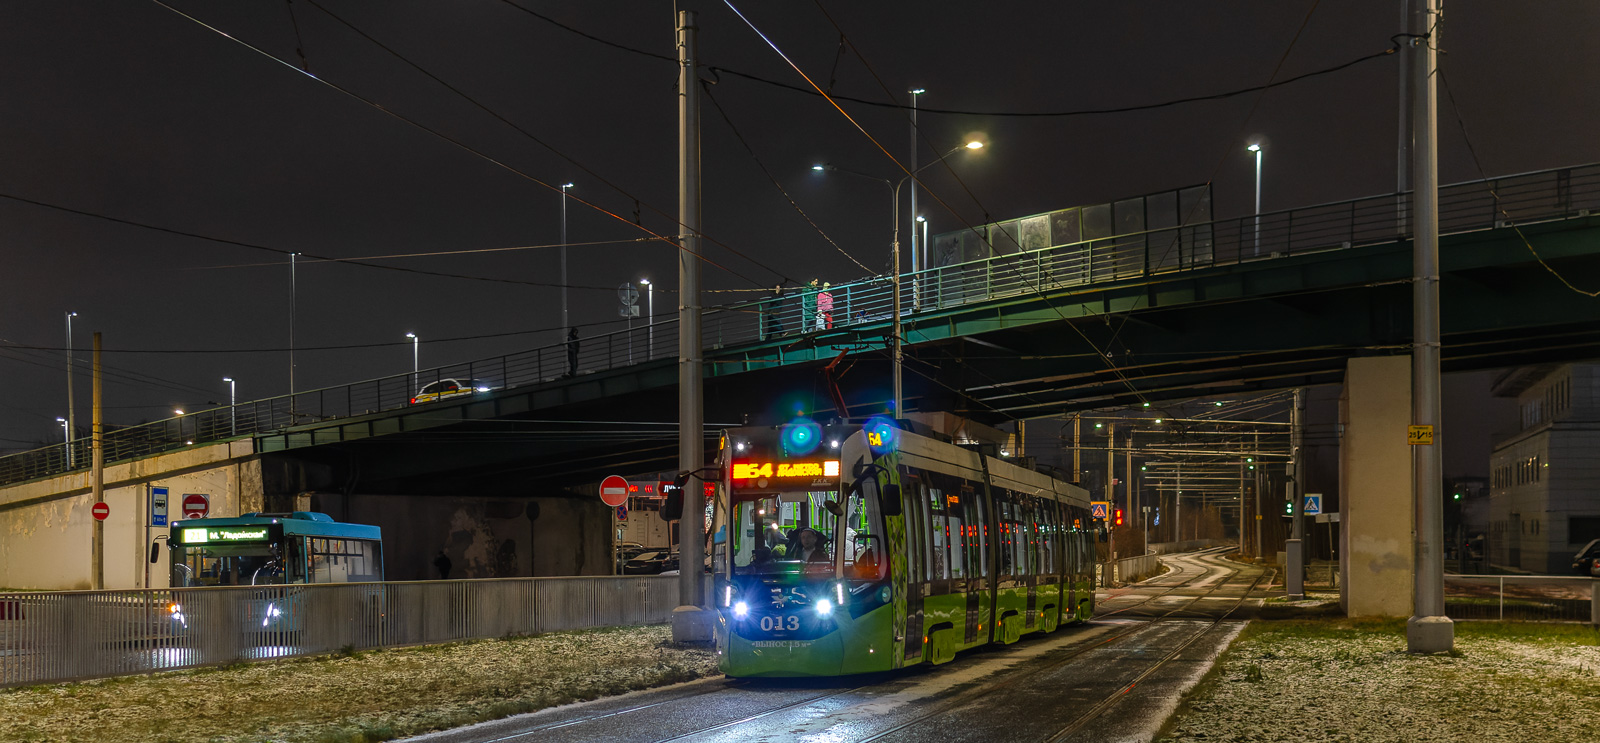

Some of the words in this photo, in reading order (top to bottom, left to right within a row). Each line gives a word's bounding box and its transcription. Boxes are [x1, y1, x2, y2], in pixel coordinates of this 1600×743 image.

[868, 432, 882, 446] 64
[748, 463, 773, 478] 64
[760, 615, 800, 631] 013
